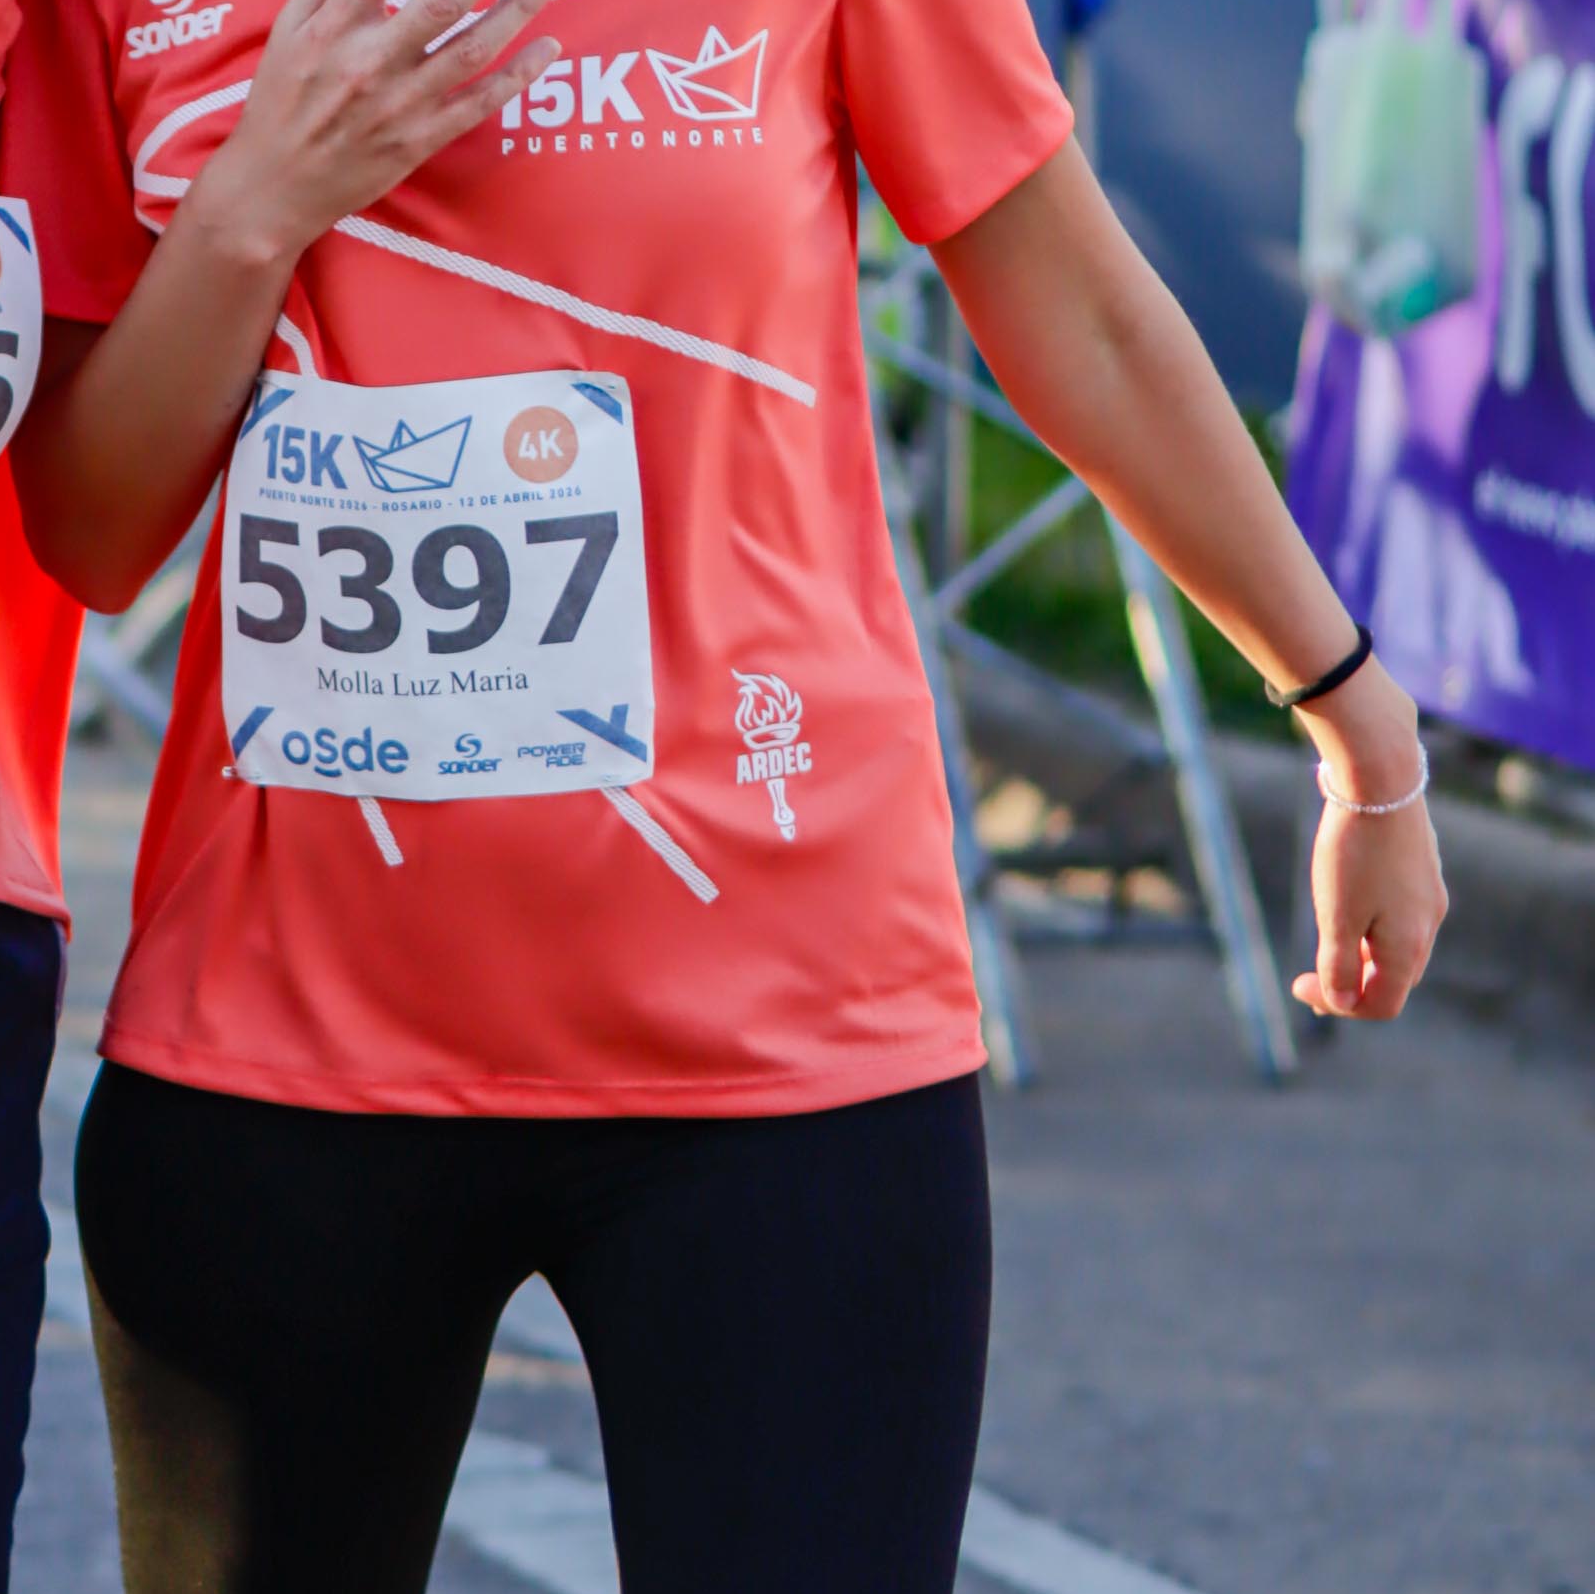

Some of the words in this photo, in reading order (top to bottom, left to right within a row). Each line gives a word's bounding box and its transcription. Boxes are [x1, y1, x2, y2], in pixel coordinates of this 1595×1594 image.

[502, 131, 645, 155] PUERTO
[663, 127, 764, 148] NORTE
[263, 423, 348, 490] 15K
[518, 427, 564, 461] 4K
[259, 487, 296, 503] PUERTO
[300, 495, 335, 509] NORTE
[382, 499, 442, 512] ROSARIO
[459, 496, 474, 508] 12
[480, 495, 497, 506] DE
[503, 490, 543, 504] ABRIL
[549, 485, 582, 499] 2026
[236, 510, 619, 655] 5397
[317, 667, 384, 696] Molla
[392, 672, 442, 697] Luz
[450, 666, 529, 695] Maria
[281, 726, 410, 778] osde
[736, 741, 813, 785] ARDEC
